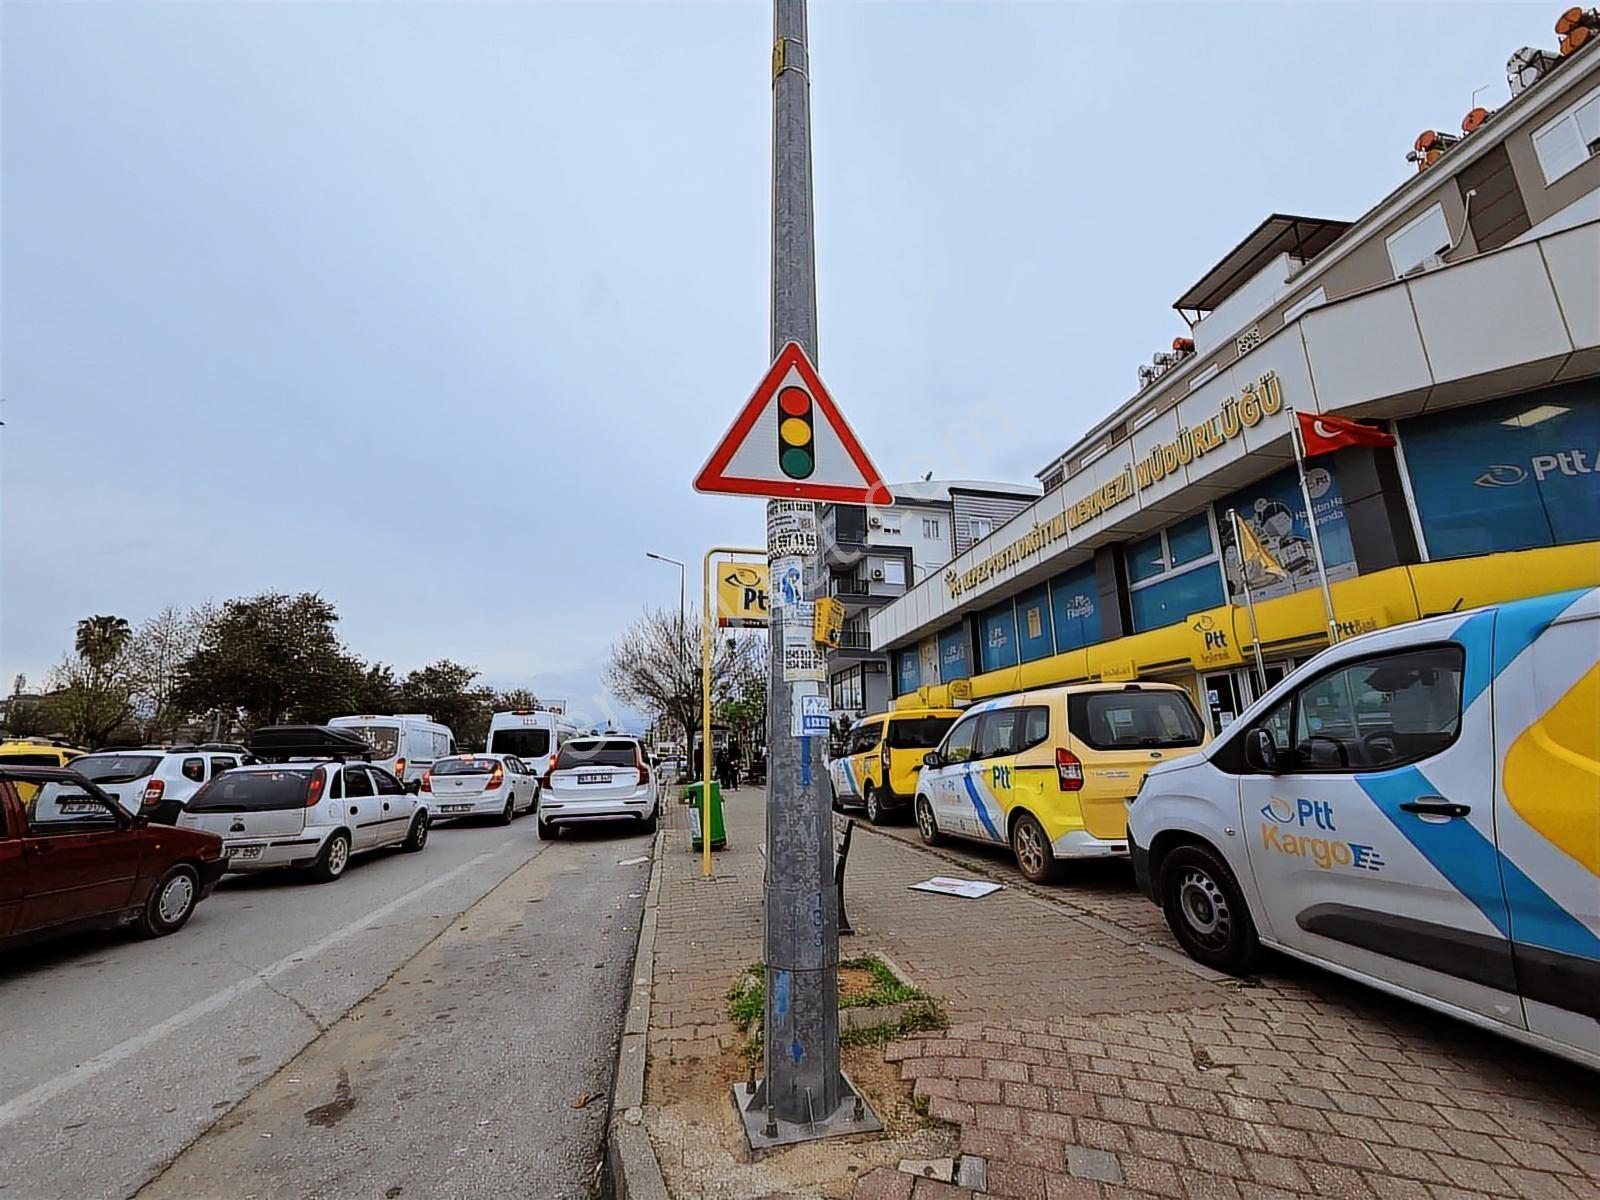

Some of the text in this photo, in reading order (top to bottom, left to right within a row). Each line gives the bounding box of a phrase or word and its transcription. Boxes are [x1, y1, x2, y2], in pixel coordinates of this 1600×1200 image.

[1135, 370, 1282, 490] MÜDÜRLÜĞÜ
[744, 588, 769, 611] Pt
[1205, 629, 1228, 650] Ptt
[992, 764, 1012, 790] Ptt
[1297, 798, 1336, 832] Ptt
[1261, 822, 1352, 870] Kargo
